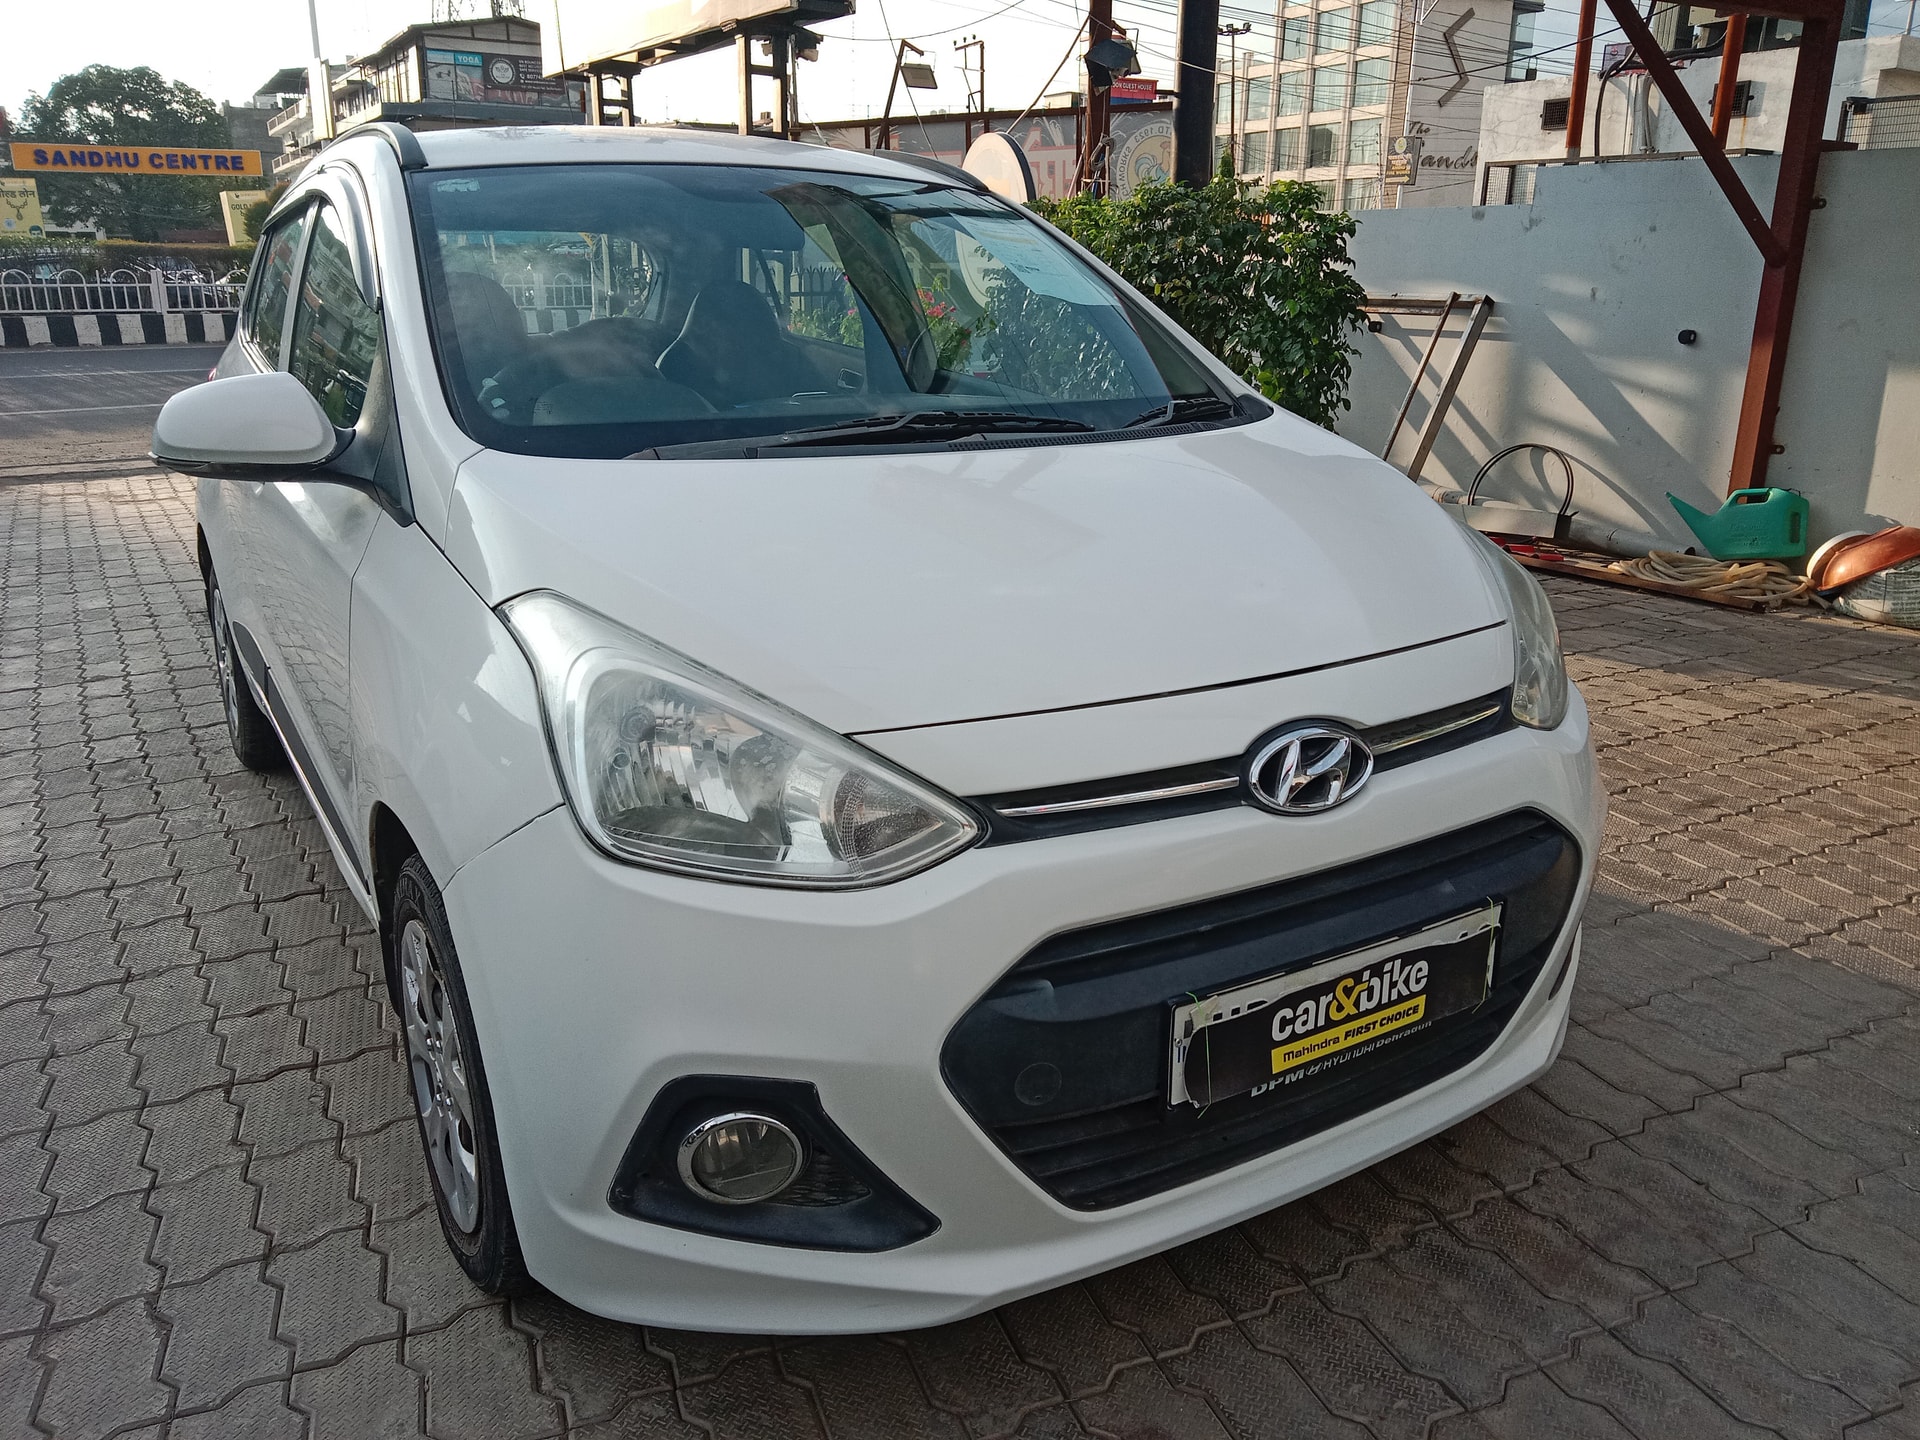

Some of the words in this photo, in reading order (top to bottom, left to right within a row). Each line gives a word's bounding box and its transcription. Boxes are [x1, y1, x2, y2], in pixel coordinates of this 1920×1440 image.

[33, 149, 140, 168] SANDHU
[149, 153, 245, 171] CENTRE
[1283, 1036, 1341, 1063] Mahindra
[1343, 1020, 1380, 1041] FIRST
[1379, 1004, 1421, 1028] CHOICE
